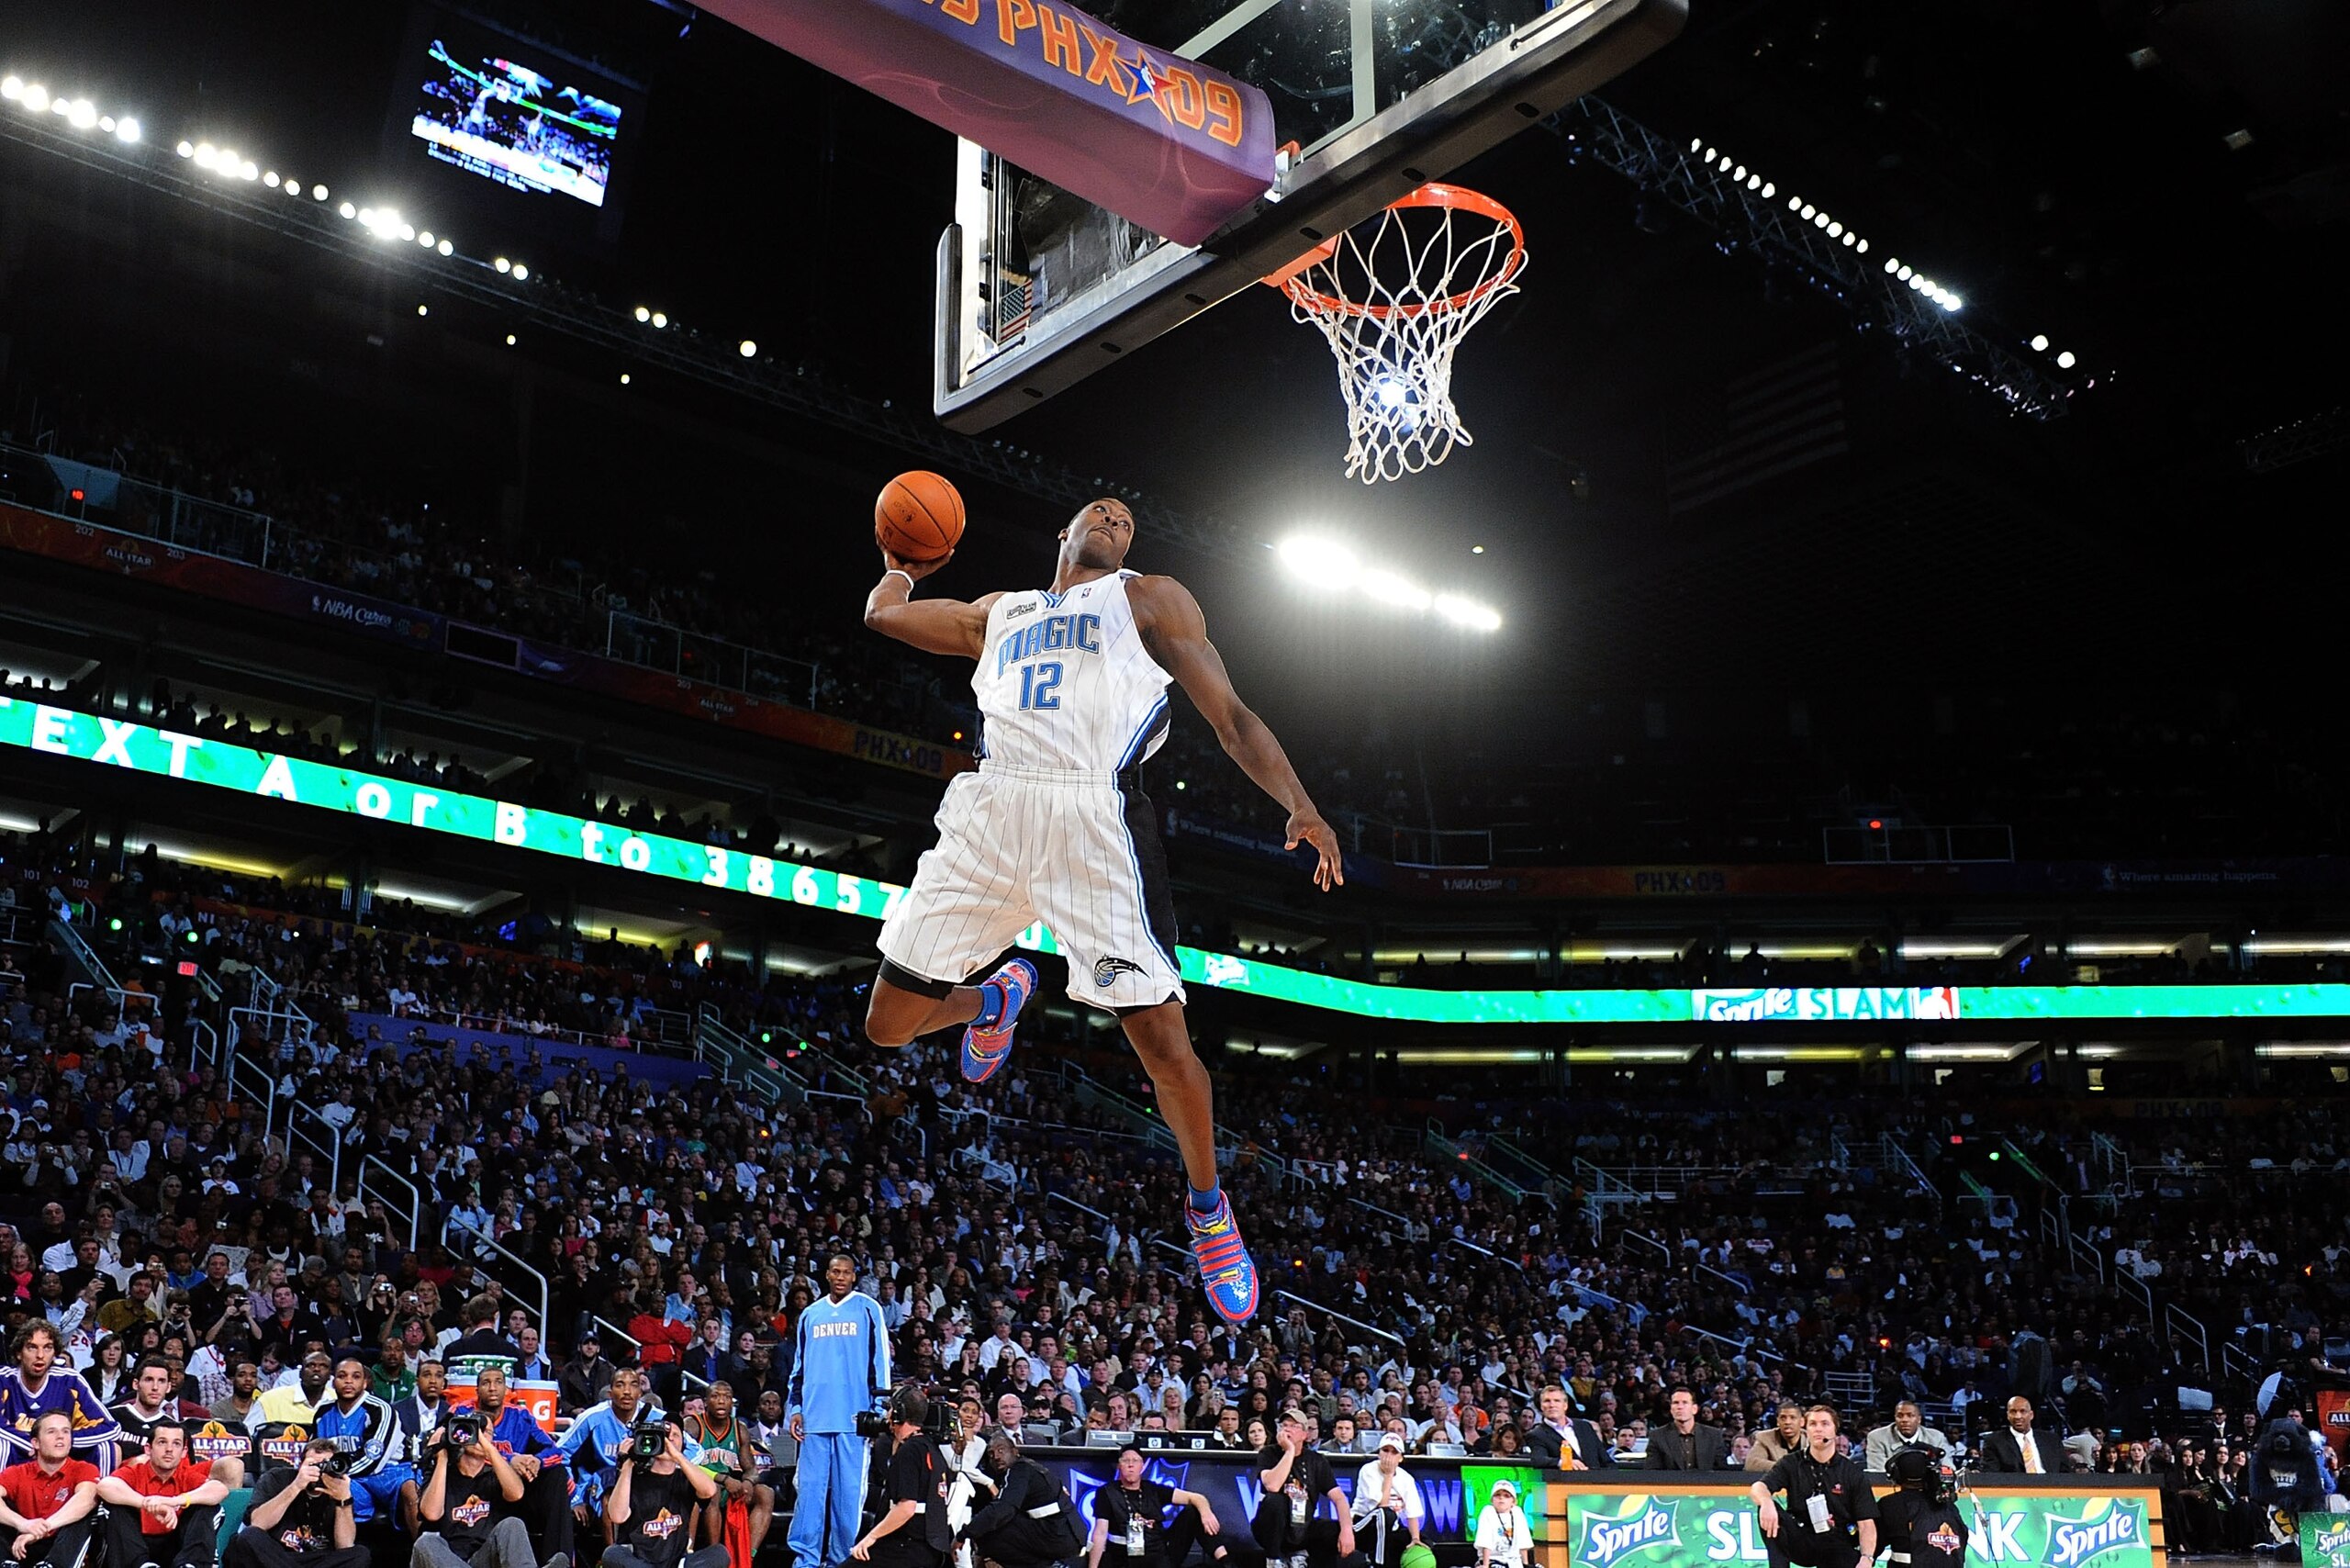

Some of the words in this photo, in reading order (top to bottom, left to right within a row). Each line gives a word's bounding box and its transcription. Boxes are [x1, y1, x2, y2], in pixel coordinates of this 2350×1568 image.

[996, 0, 1127, 96] PHX
[1166, 66, 1243, 147] 09
[323, 599, 353, 620] NBA
[354, 607, 393, 628] Cares
[997, 612, 1101, 680] MAGIC
[1019, 661, 1064, 711] 12
[855, 731, 898, 761] PHX
[0, 695, 204, 779] EXT
[256, 754, 297, 793] A
[356, 782, 439, 827] or
[494, 801, 527, 846] B
[580, 820, 652, 872] to
[24, 869, 40, 880] 101
[73, 878, 90, 890] 102
[1635, 871, 1679, 893] PHX
[2120, 871, 2159, 882] Where
[2165, 871, 2220, 884] amazing
[1809, 988, 1913, 1019] SLAM
[812, 1321, 857, 1338] DENVER
[532, 1400, 551, 1421] G
[1587, 1503, 1670, 1563] Sprite
[2053, 1505, 2134, 1566] Sprite
